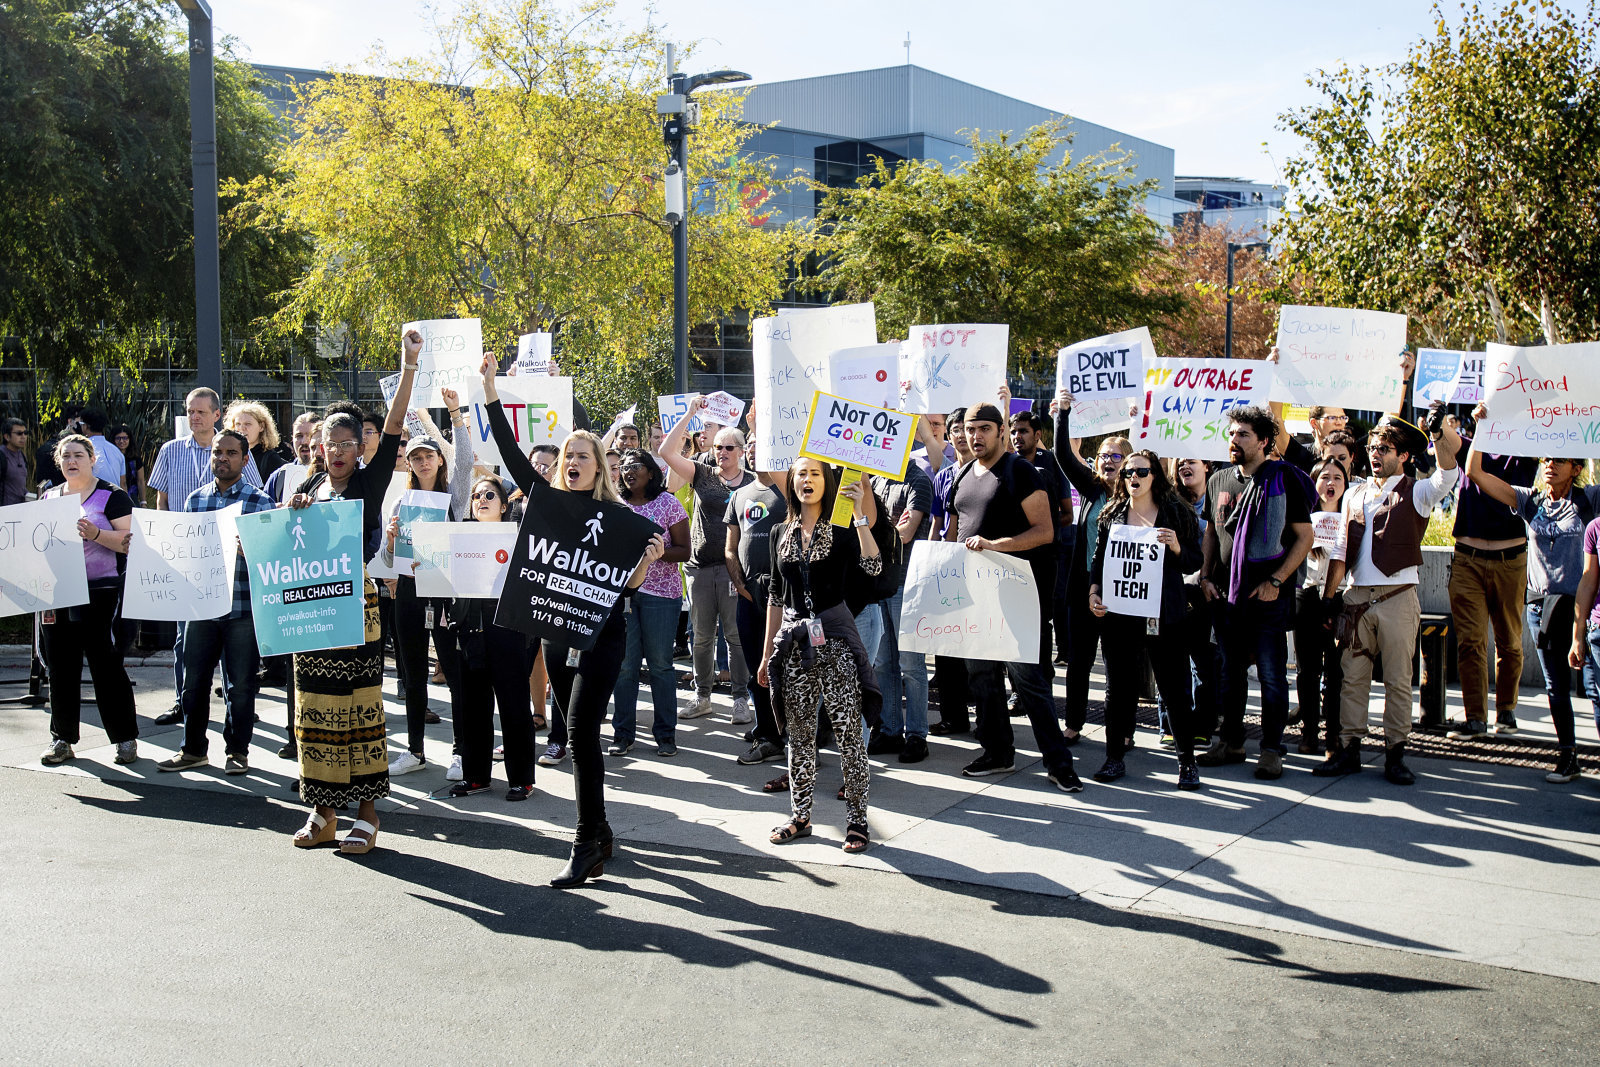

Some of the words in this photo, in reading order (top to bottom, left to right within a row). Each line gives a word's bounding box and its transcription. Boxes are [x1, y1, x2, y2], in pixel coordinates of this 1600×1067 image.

[420, 327, 466, 353] lieve
[922, 329, 976, 348] NOT
[517, 360, 547, 368] Walkout
[804, 361, 826, 379] at
[1077, 348, 1130, 373] DON'T
[1069, 374, 1092, 393] BE
[1096, 372, 1137, 392] EVIL
[1173, 367, 1254, 391] OUTRAGE
[1495, 362, 1568, 393] Stand
[674, 394, 688, 416] 5
[1526, 398, 1600, 428] together
[827, 423, 895, 451] GOOGLE
[1485, 420, 1518, 441] for
[32, 520, 67, 553] OK
[145, 520, 157, 537] I
[172, 518, 217, 538] CAN'T
[161, 541, 221, 561] BELIEVE
[1110, 540, 1159, 562] TIME'S
[140, 571, 175, 586] HAVE
[183, 570, 203, 583] TO
[256, 552, 352, 586] Walkout
[1122, 561, 1142, 580] UP
[519, 567, 547, 585] FOR
[550, 578, 580, 596] REAL
[1112, 579, 1149, 601] TECH
[144, 590, 178, 603] THIS
[262, 593, 283, 606] FOR
[284, 588, 306, 603] REAL
[306, 583, 352, 600] CHANGE
[277, 608, 337, 625] go/walkout-info
[532, 609, 552, 624] 11/1
[281, 626, 297, 638] 11/1
[304, 623, 335, 635] 11:10am
[916, 616, 981, 644] Google
